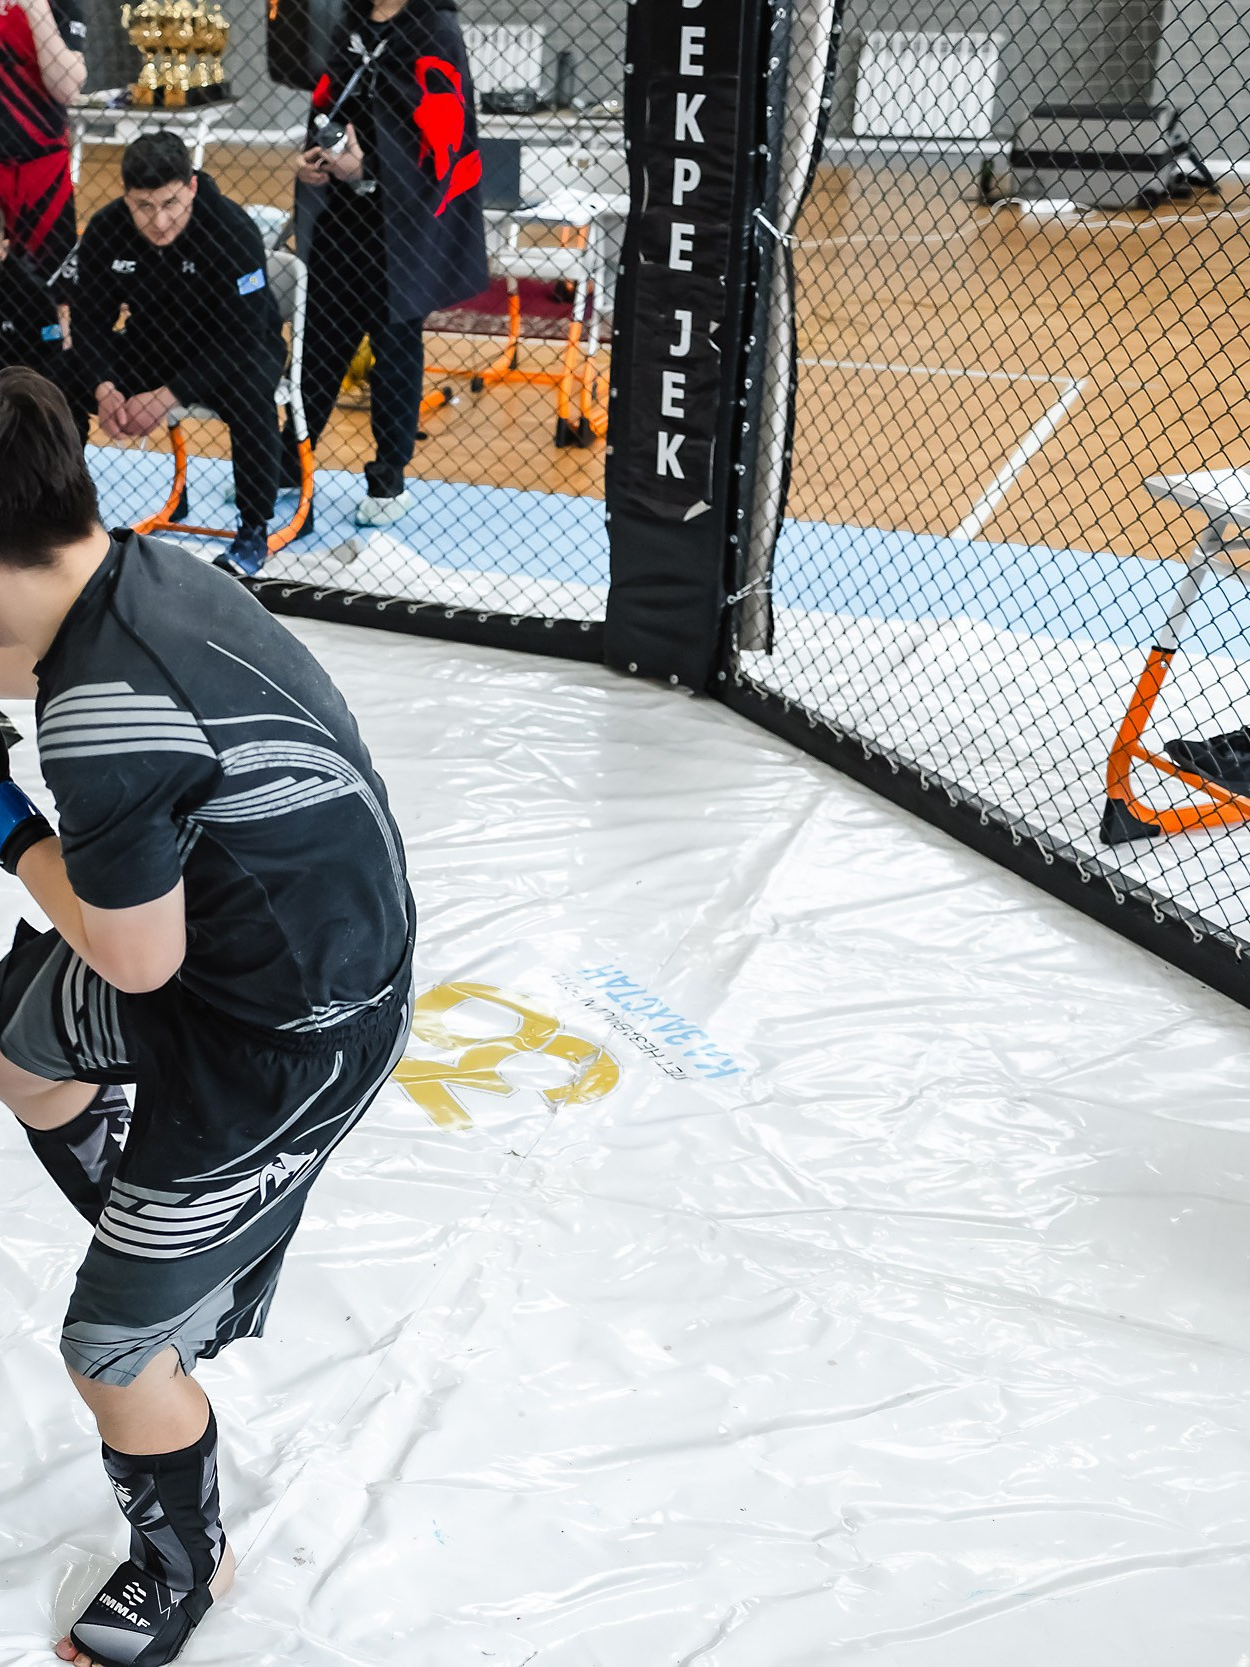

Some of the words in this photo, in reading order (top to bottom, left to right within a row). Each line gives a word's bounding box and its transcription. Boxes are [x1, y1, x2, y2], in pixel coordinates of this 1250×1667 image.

[668, 0, 707, 272] EKPE
[656, 310, 693, 479] JEK
[577, 964, 746, 1080] КАЗАХСТАН
[98, 1592, 151, 1628] IMMAF
